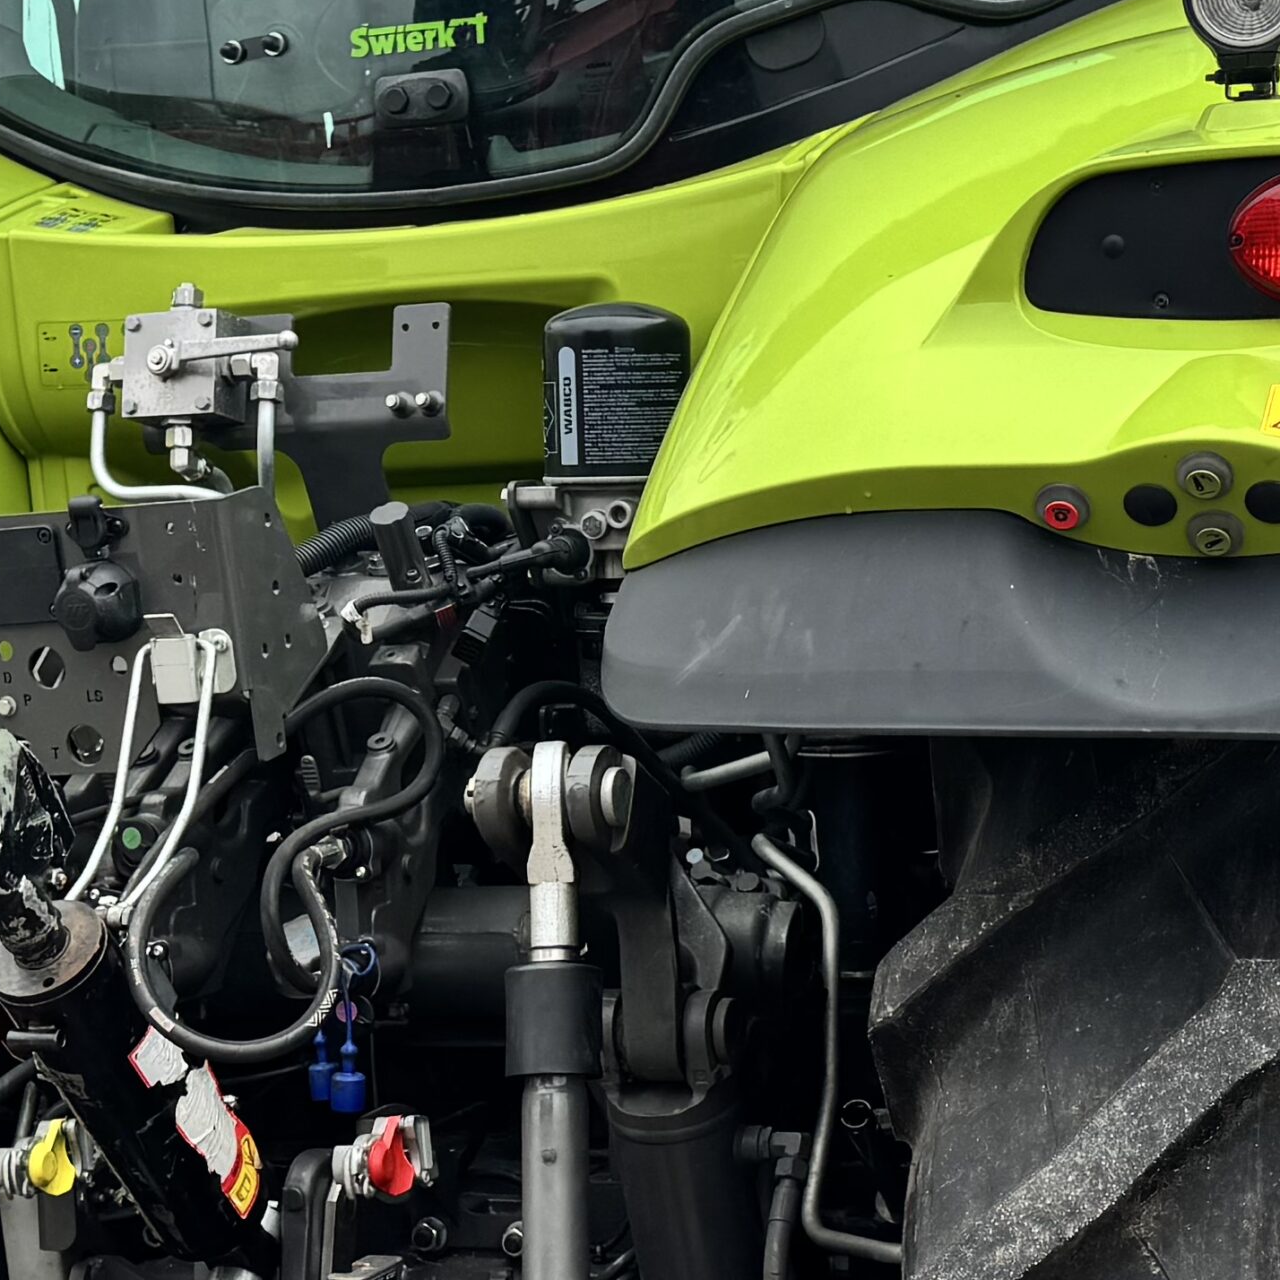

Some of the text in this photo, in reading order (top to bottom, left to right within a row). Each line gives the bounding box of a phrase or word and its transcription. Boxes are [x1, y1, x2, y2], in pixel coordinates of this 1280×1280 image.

[563, 376, 573, 435] WABCO
[3, 671, 12, 684] D
[23, 694, 32, 706] P
[86, 689, 104, 703] LS
[51, 746, 59, 759] T
